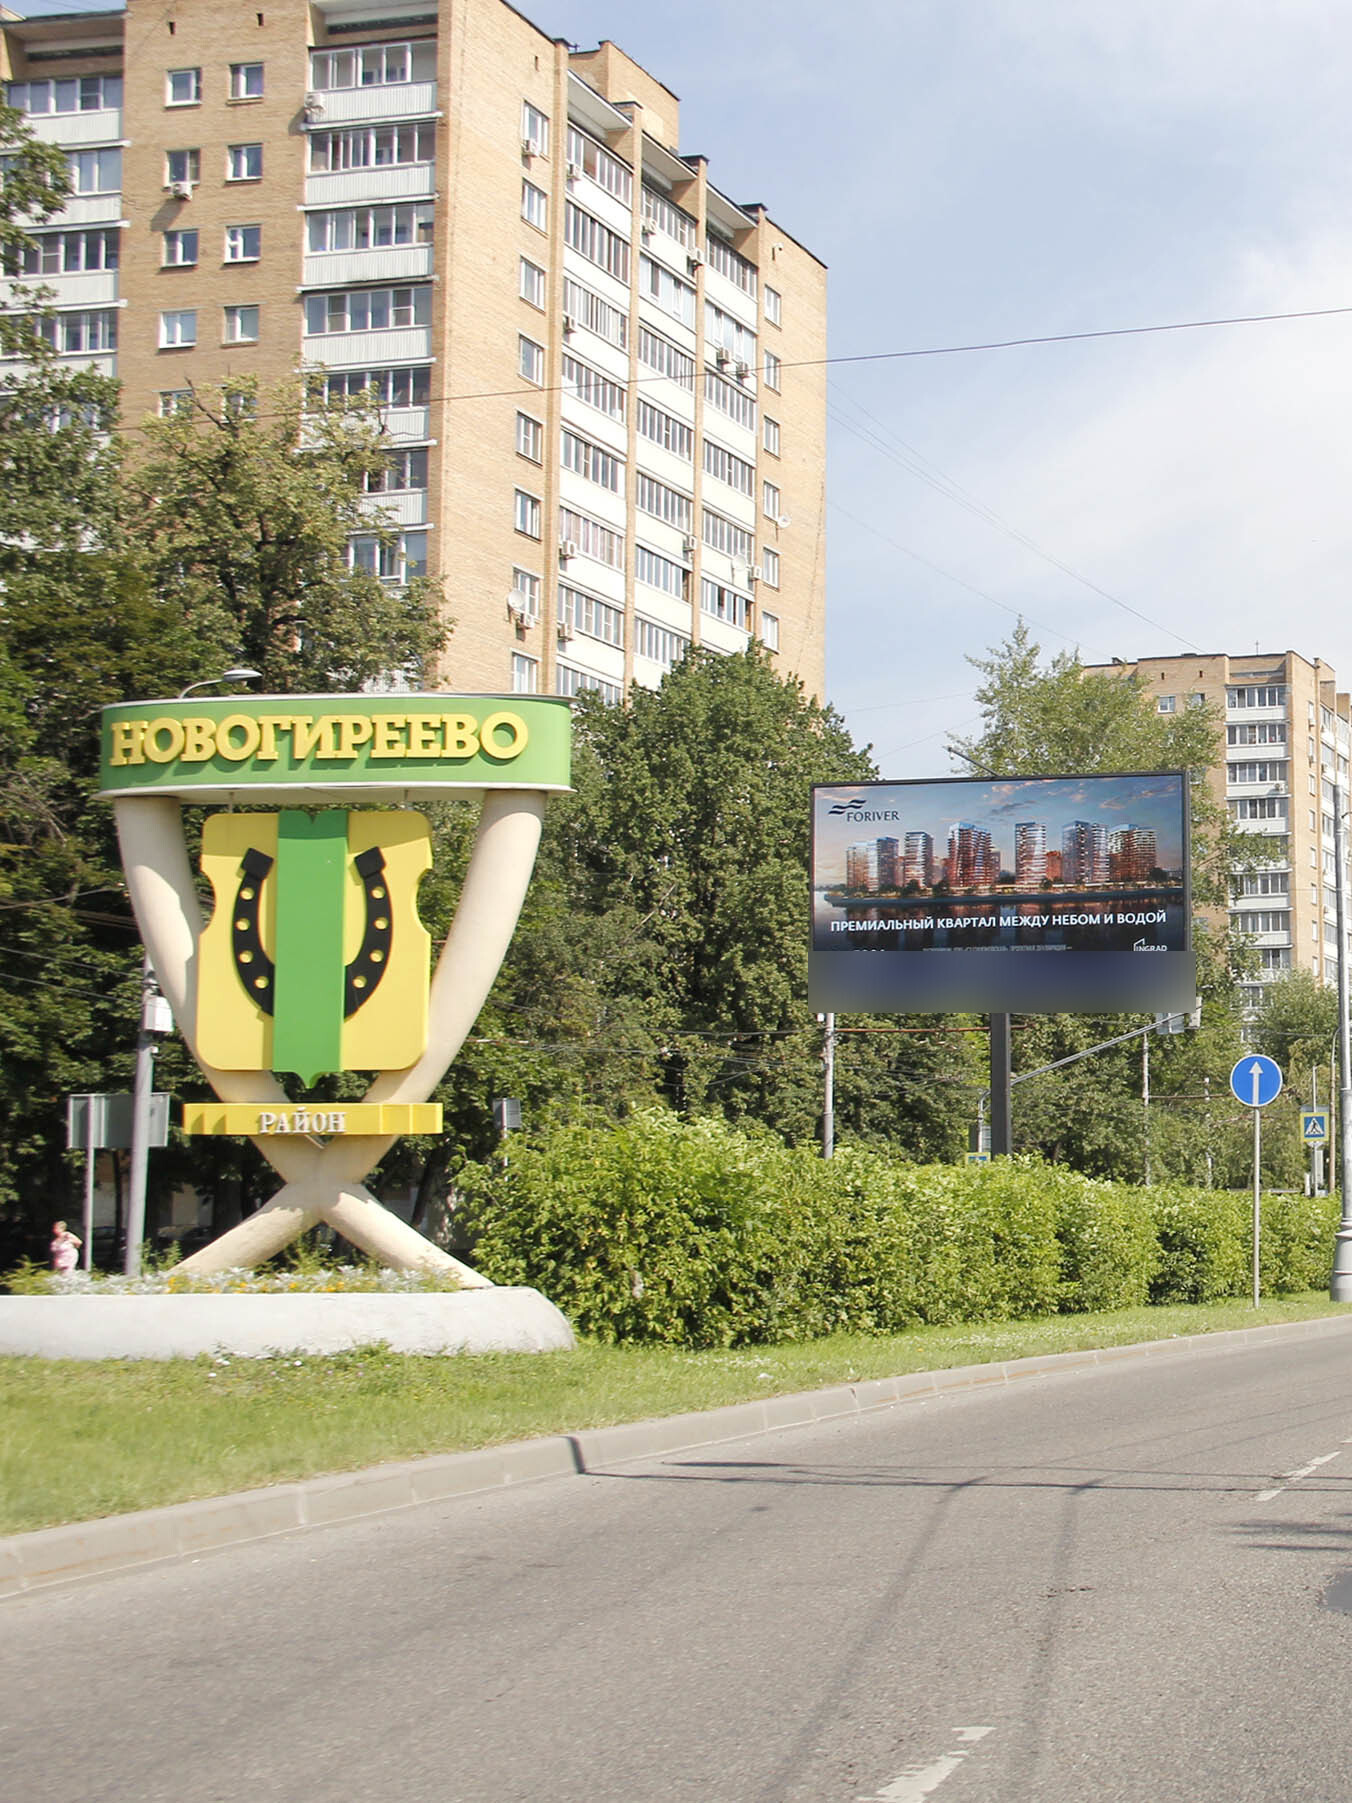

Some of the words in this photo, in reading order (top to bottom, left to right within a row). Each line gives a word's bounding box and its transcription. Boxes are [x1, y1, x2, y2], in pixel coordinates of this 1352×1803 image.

[109, 711, 529, 767] НОВОГИРЕЕВО
[846, 810, 900, 823] FORIVER
[831, 916, 934, 932] ПРЕМИАЛЬНЫЙ
[937, 916, 996, 929] КВАРТАЛ
[999, 915, 1050, 928] МЕЖДУ
[1052, 913, 1101, 926] НЕБОМ
[1104, 914, 1114, 925] И
[1116, 909, 1167, 925] ВОДОЙ
[259, 1106, 347, 1134] РАЙОН
